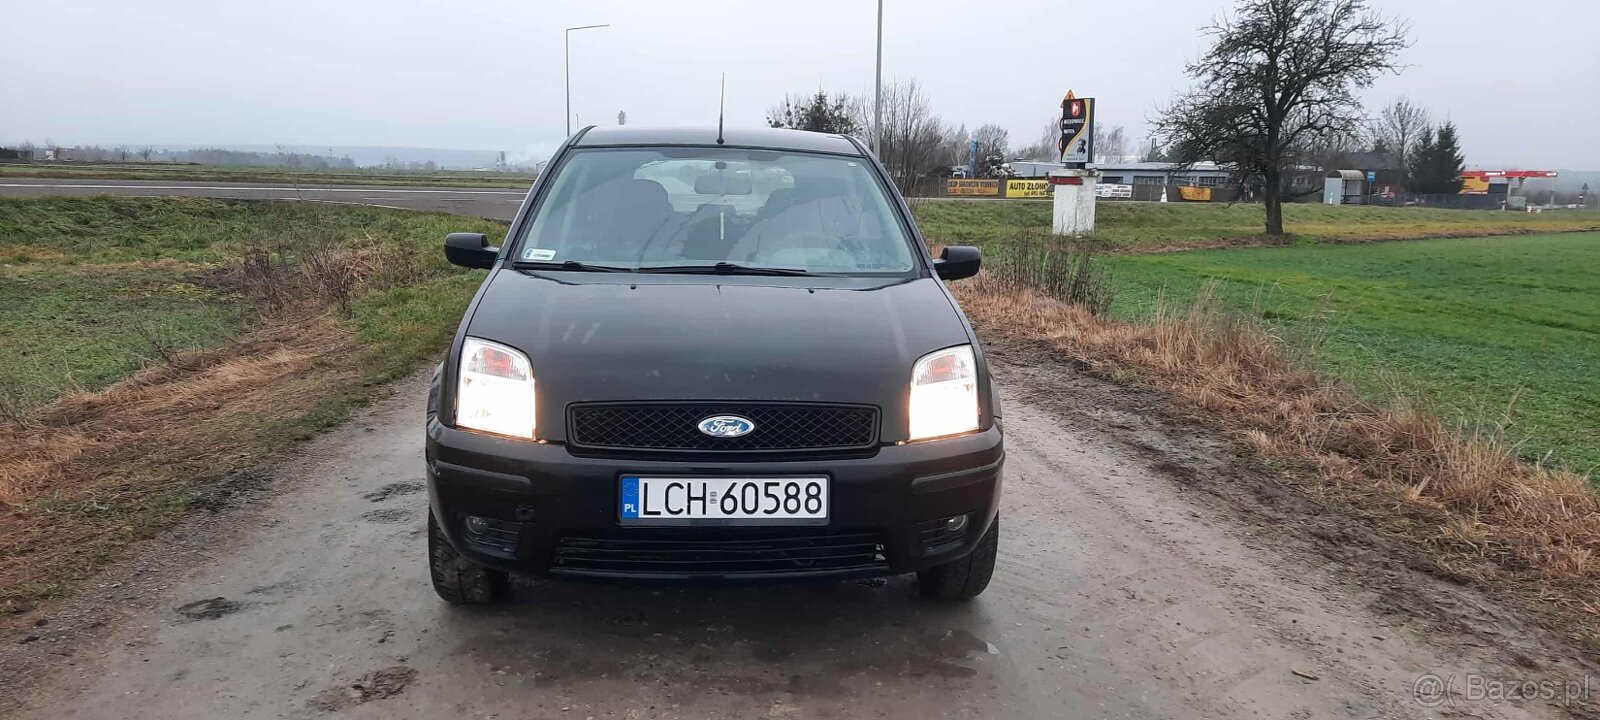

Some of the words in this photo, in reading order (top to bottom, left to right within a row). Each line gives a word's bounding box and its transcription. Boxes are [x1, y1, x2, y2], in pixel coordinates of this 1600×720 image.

[1009, 182, 1025, 190] AUTO
[704, 419, 742, 432] Ford
[643, 482, 707, 515] LCH
[720, 482, 822, 515] 60588
[624, 504, 637, 513] PL
